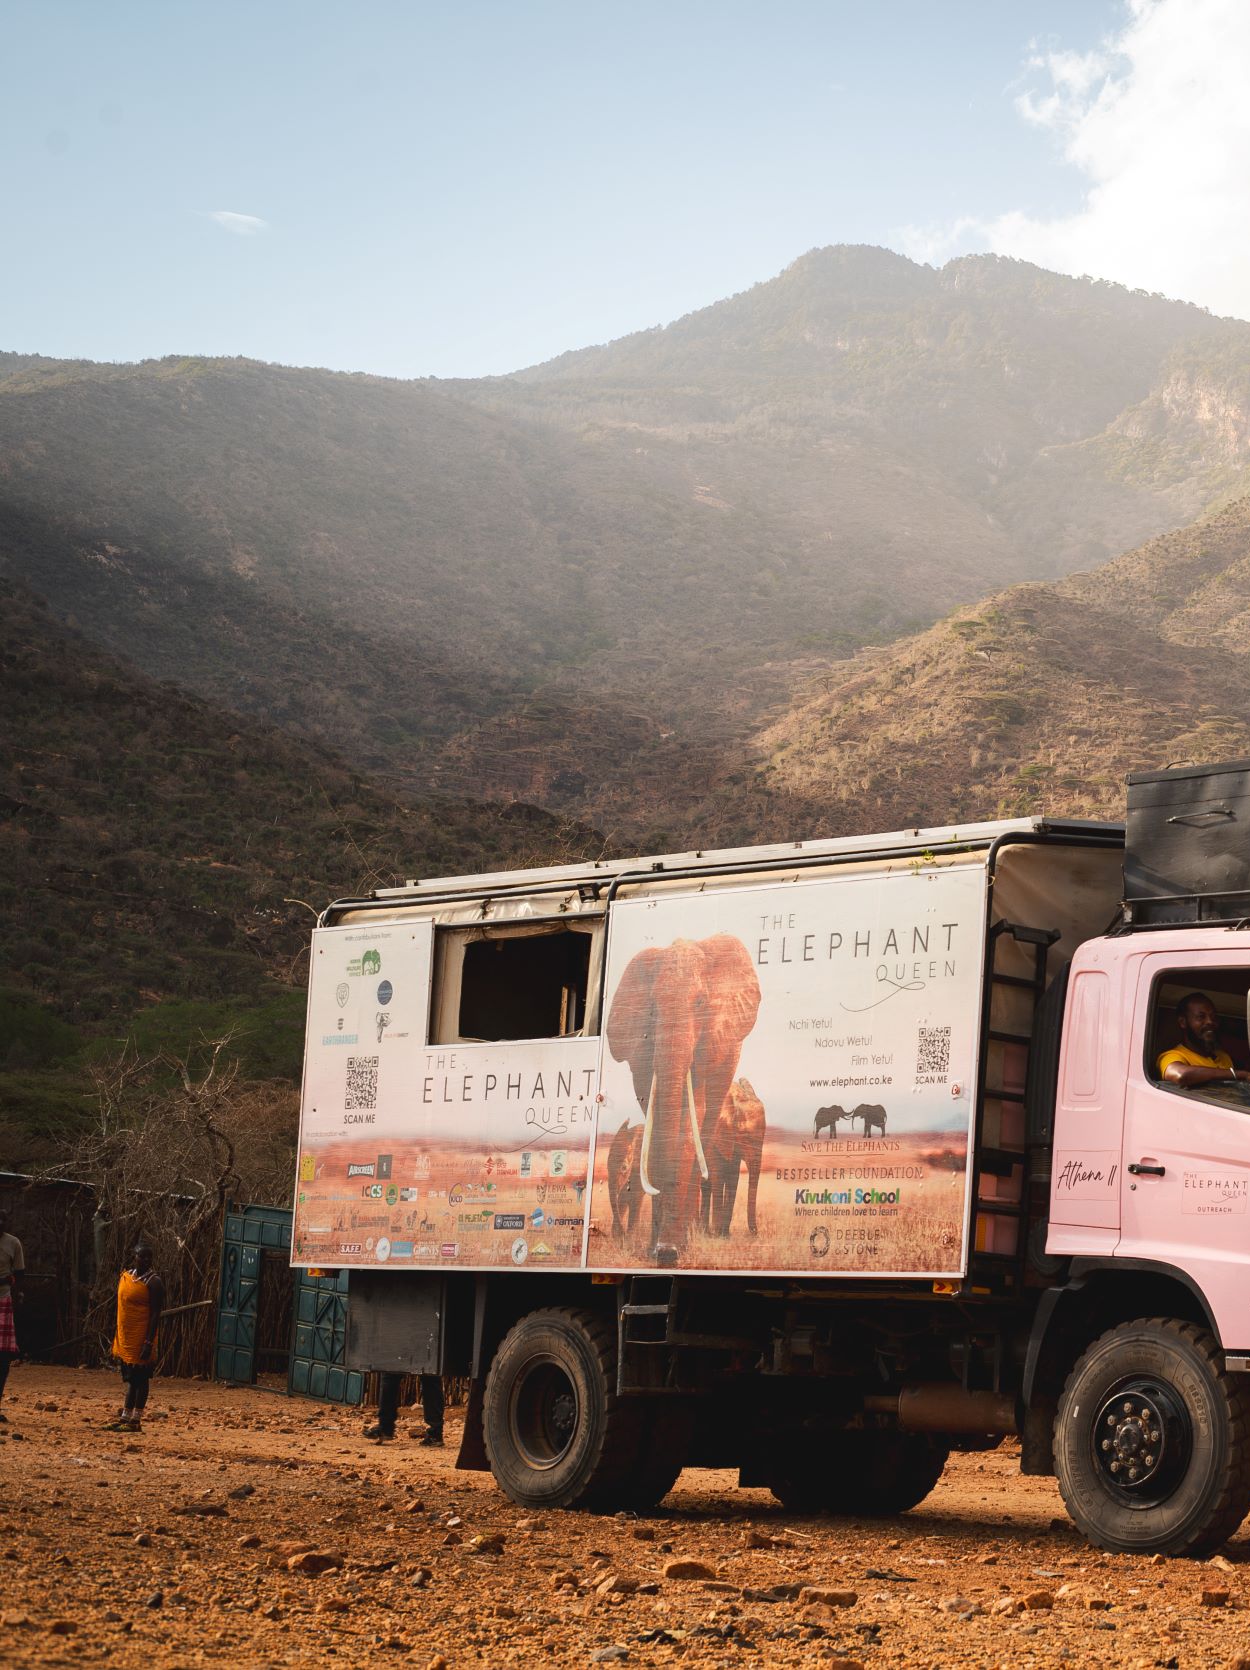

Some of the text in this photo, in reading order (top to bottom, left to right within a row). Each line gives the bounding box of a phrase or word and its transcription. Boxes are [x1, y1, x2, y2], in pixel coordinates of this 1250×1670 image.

[760, 913, 796, 930] THE
[758, 923, 959, 965] ELEPHANT
[789, 1017, 833, 1030] Nchi Yetu!
[815, 1035, 873, 1048] Ndovu Wetu!
[426, 1053, 457, 1070] THE
[851, 1054, 893, 1066] Film Yetu!
[423, 1069, 595, 1104] ELEPHANT
[810, 1075, 893, 1088] www.elephant.co.ke
[915, 1075, 948, 1085] SCAN ME
[344, 1114, 376, 1124] SCAN ME
[801, 1140, 900, 1152] SAVE THE ELEPHANTS
[776, 1166, 923, 1180] BESTSELLER FOUNDATION
[1057, 1160, 1104, 1190] Athena
[1184, 1180, 1248, 1189] ELEPHANT
[795, 1188, 900, 1204] Kivukoni School
[795, 1206, 898, 1216] Where children love to learn
[836, 1229, 880, 1241] DEEBLE
[843, 1244, 878, 1255] STONE
